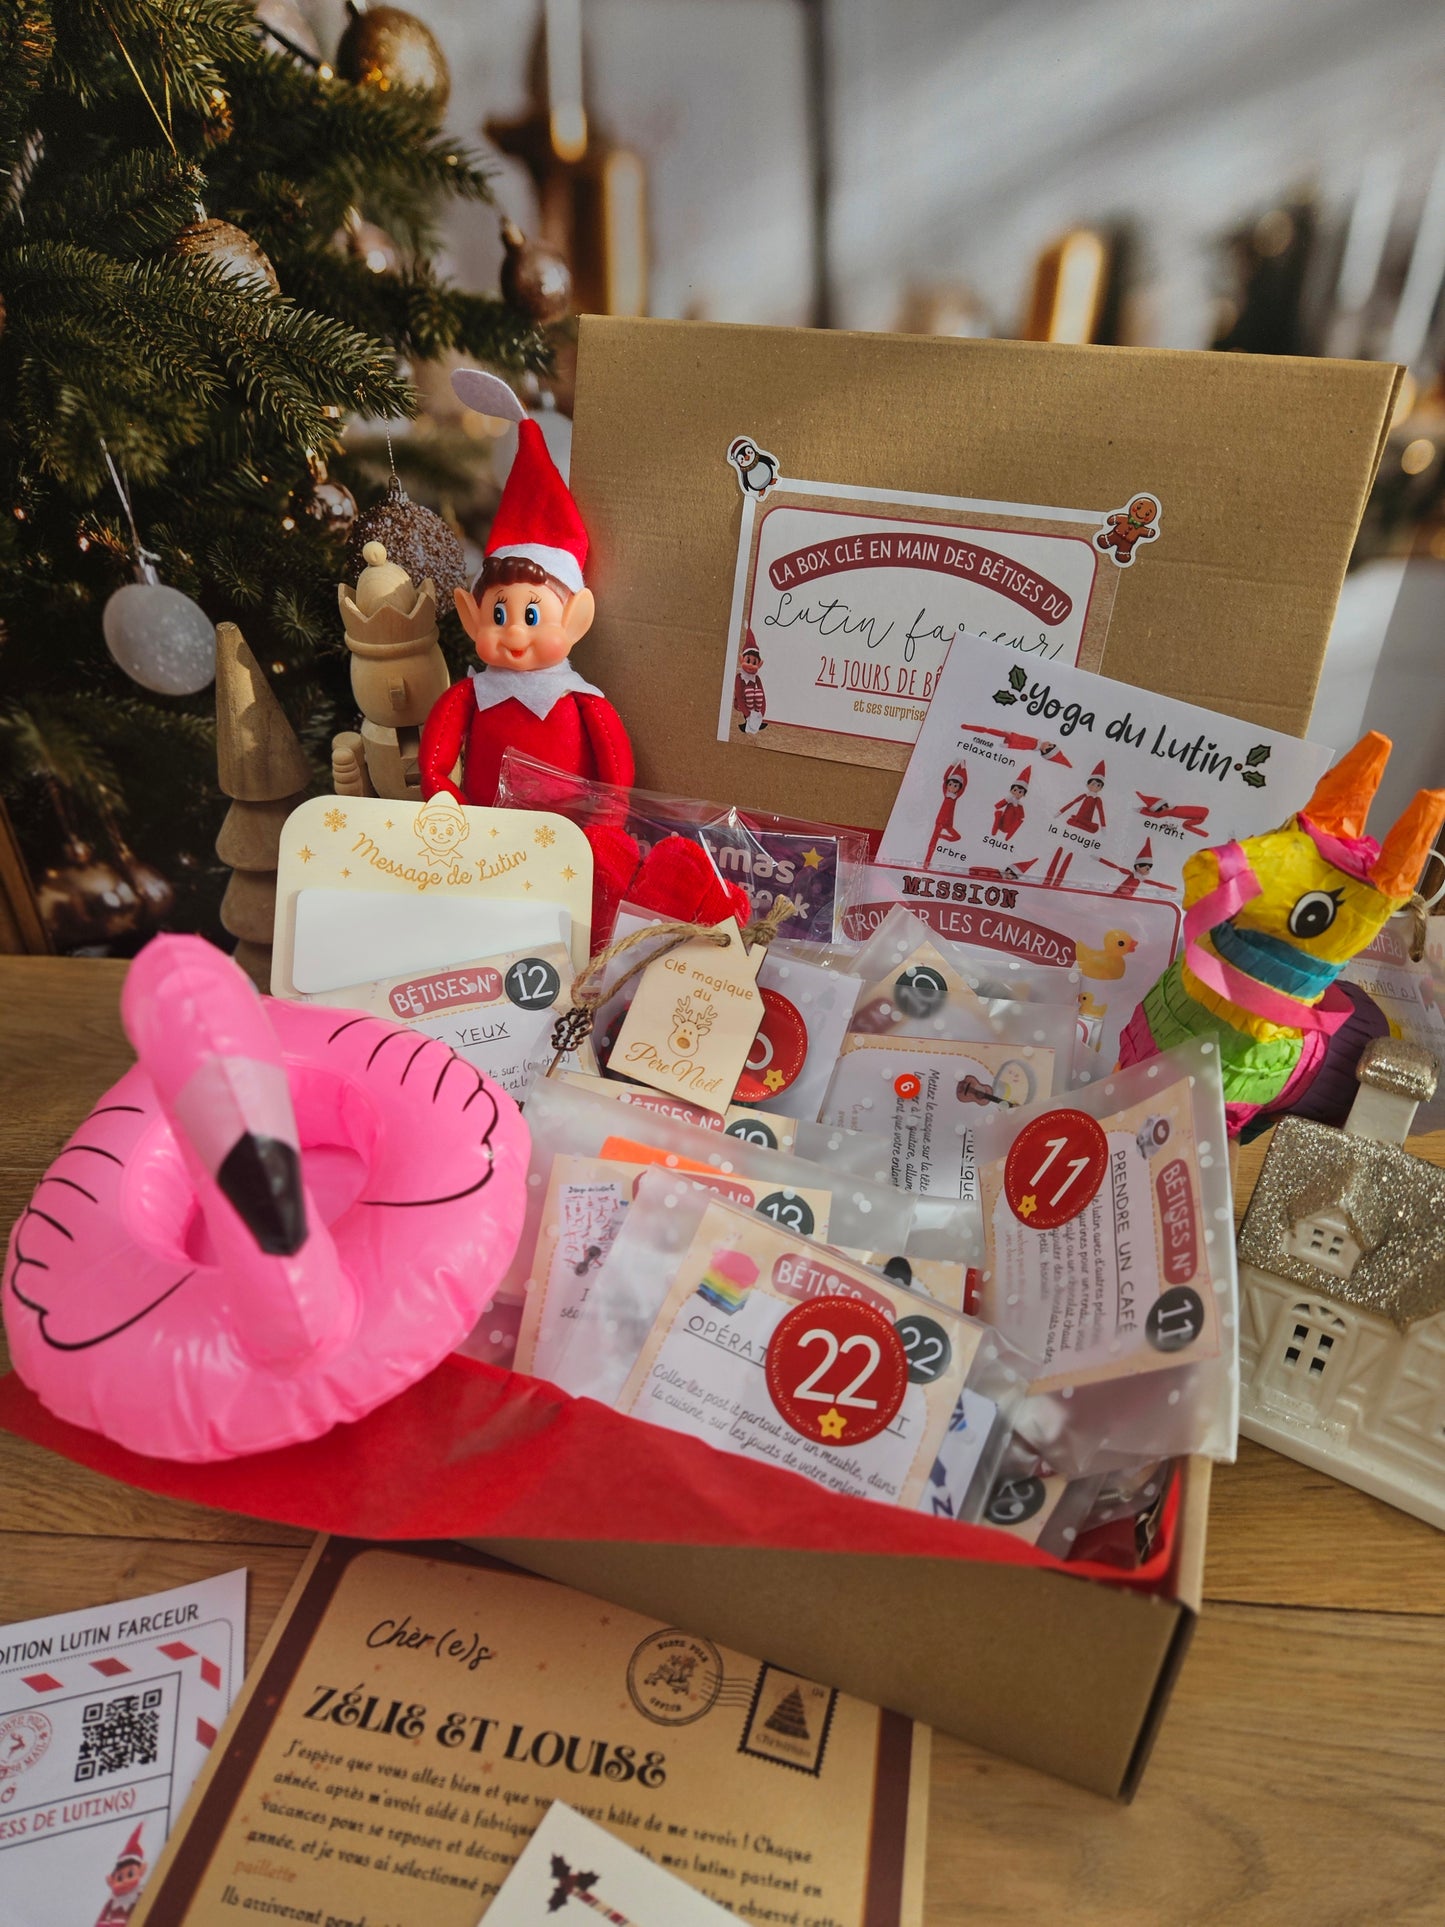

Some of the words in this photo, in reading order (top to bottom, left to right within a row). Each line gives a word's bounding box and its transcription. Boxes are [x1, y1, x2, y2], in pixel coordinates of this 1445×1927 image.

[772, 563, 796, 585] LA
[796, 548, 831, 575] BOX
[834, 538, 865, 564] CLÉ
[870, 540, 892, 559] EN
[897, 540, 940, 562] MAIN
[943, 546, 977, 571] DES
[979, 558, 1044, 603] BÊTISES
[1041, 593, 1069, 620] DU
[764, 592, 895, 649] Lutin
[817, 655, 836, 684] 24
[841, 660, 891, 692] JOURS
[897, 667, 918, 696] DE
[853, 699, 865, 713] et
[865, 701, 883, 717] ses
[1025, 679, 1095, 737] Yoga
[1104, 712, 1145, 749] du
[1152, 724, 1233, 782] Lutin
[956, 740, 1017, 768] relaxation
[982, 834, 1015, 854] squat
[1047, 823, 1058, 834] la
[1061, 827, 1102, 852] bougie
[1143, 819, 1185, 841] enfant
[351, 832, 443, 892] Message
[446, 864, 473, 886] de
[475, 850, 528, 882] Lutin
[935, 844, 968, 862] arbre
[902, 875, 1019, 910] MISSION
[939, 909, 974, 934] LES
[979, 918, 1072, 966] CANARDS
[393, 974, 470, 1014] BÊTISES
[511, 964, 554, 1002] 12
[664, 957, 688, 976] Clé
[692, 968, 755, 1002] magique
[692, 987, 712, 1002] du
[455, 1021, 509, 1044] YEUX
[624, 1041, 671, 1075] Père
[671, 1055, 724, 1095] Noël
[900, 1081, 915, 1092] 6
[926, 1068, 940, 1100] Mettez
[924, 1100, 938, 1111] le
[920, 1112, 934, 1143] casque
[921, 1162, 933, 1174] la
[922, 1143, 931, 1161] sur
[1029, 1136, 1091, 1207] 11
[919, 1174, 931, 1193] tête
[1112, 1150, 1131, 1234] PRENDRE
[1092, 1206, 1103, 1232] lutin
[1160, 1162, 1190, 1249] BÊTISES
[1078, 1251, 1089, 1274] pour
[1093, 1232, 1102, 1257] avec
[1119, 1241, 1134, 1273] UN
[1170, 1254, 1192, 1278] N°
[1118, 1281, 1138, 1334] CAFÉ
[1157, 1299, 1194, 1342] 11
[792, 1327, 882, 1410] 22
[900, 1326, 944, 1376] 22
[652, 1363, 688, 1390] Collez
[686, 1379, 705, 1398] les
[738, 1409, 782, 1437] partout
[782, 1431, 803, 1446] sur
[803, 1441, 819, 1457] un
[820, 1450, 863, 1482] meuble,
[867, 1472, 898, 1497] dans
[707, 1416, 728, 1431] sur
[728, 1419, 747, 1441] les
[740, 1434, 781, 1459] jouets
[782, 1451, 798, 1469] de
[797, 1462, 828, 1484] votre
[60, 1624, 111, 1655] LUTIN
[117, 1603, 199, 1641] FARCEUR
[303, 1684, 427, 1740] ZÉLIE
[436, 1712, 499, 1754] ET
[503, 1724, 667, 1790] LOUISE
[33, 1808, 58, 1832] DE
[63, 1787, 137, 1824] LUTIN(S)
[282, 1739, 344, 1765] J'espère
[347, 1759, 373, 1773] que
[378, 1763, 408, 1780] vous
[411, 1767, 447, 1789] allez
[450, 1773, 481, 1795] bien
[485, 1784, 500, 1798] et
[503, 1791, 530, 1806] que
[608, 1803, 641, 1829] hâte
[645, 1812, 663, 1833] de
[667, 1824, 688, 1838] me
[693, 1829, 738, 1849] revoir
[753, 1835, 814, 1865] Chaque
[260, 1801, 328, 1825] vacances
[328, 1815, 365, 1833] pour
[367, 1824, 385, 1838] se
[387, 1827, 441, 1852] reposer
[446, 1839, 463, 1854] et
[325, 1783, 364, 1801] après
[424, 1801, 459, 1821] aidé
[461, 1808, 471, 1824] à
[661, 1854, 689, 1870] mes
[693, 1854, 737, 1880] lutins
[740, 1869, 799, 1894] partent
[803, 1884, 823, 1898] en
[300, 1840, 318, 1855] et
[313, 1841, 335, 1862] je
[337, 1849, 371, 1868] vous
[373, 1854, 392, 1872] ai
[392, 1858, 479, 1891] sélectionné
[242, 1897, 323, 1926] arriveront
